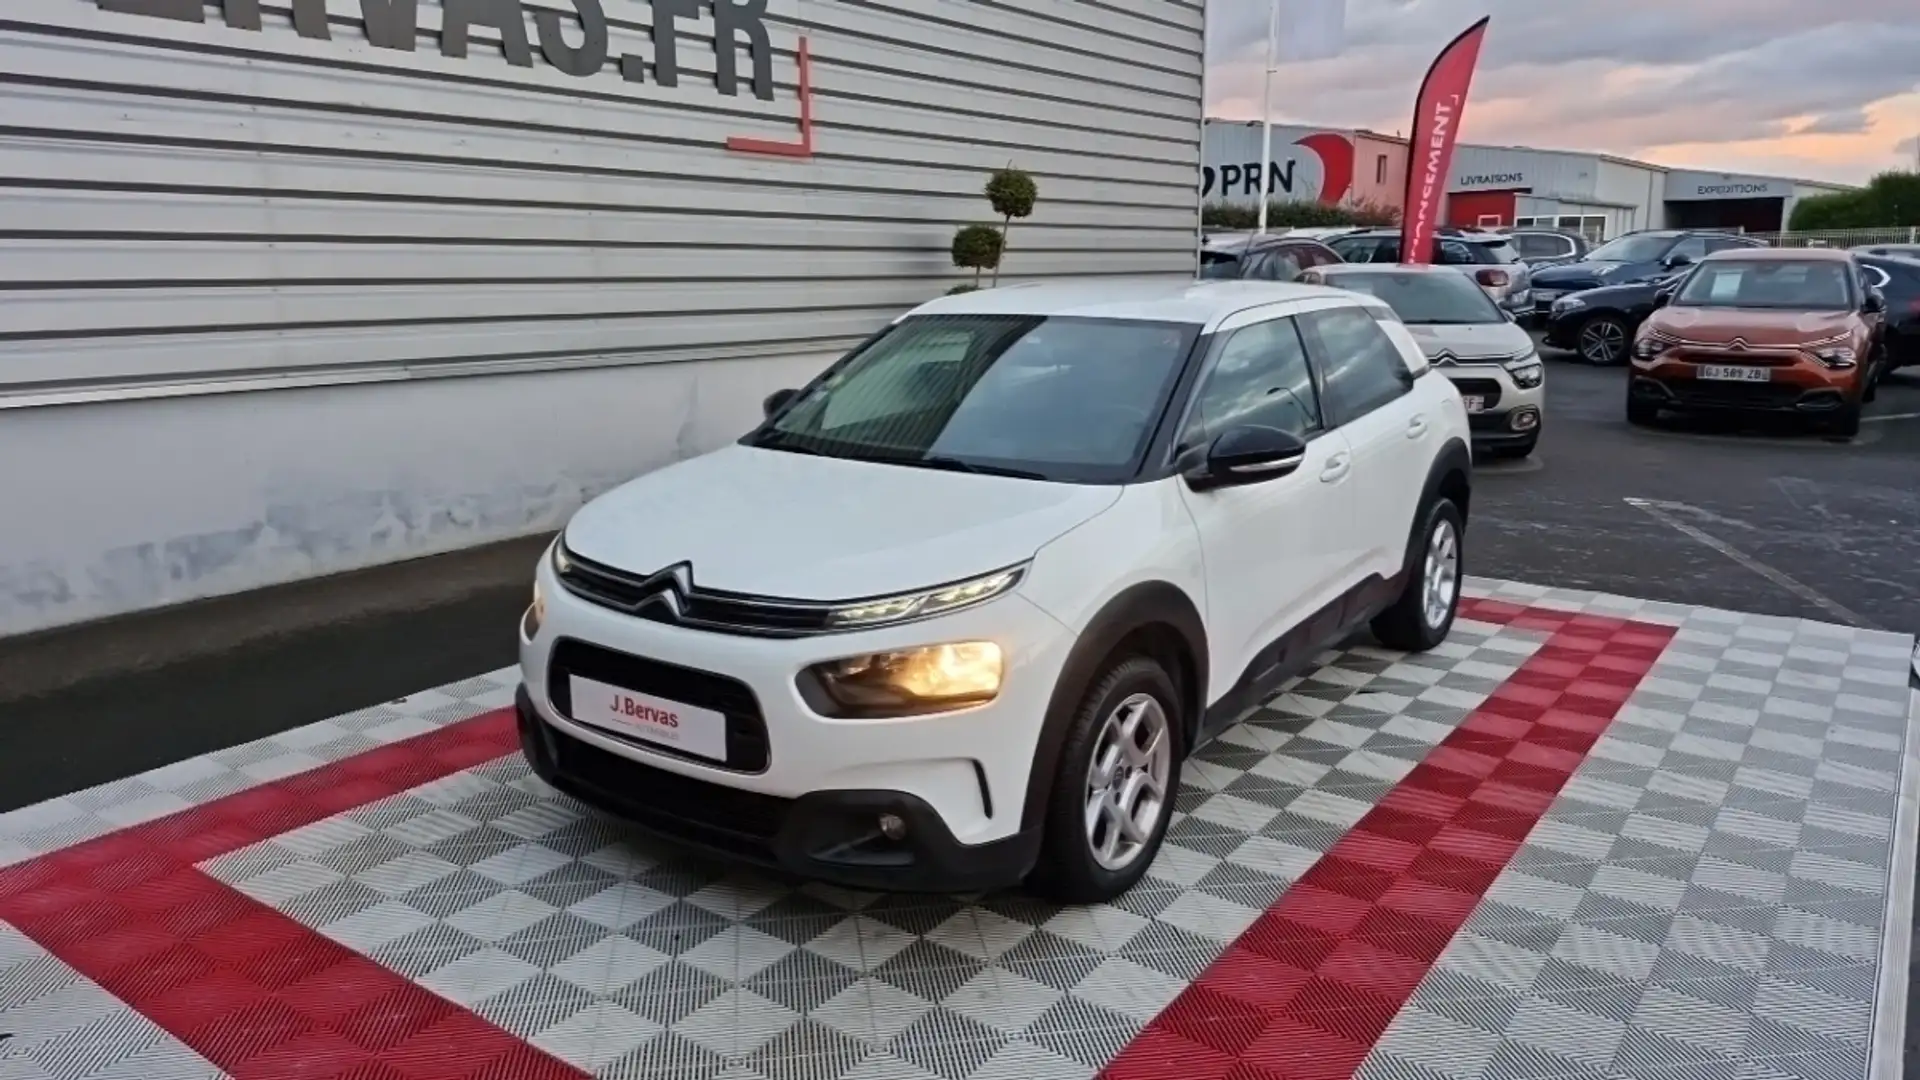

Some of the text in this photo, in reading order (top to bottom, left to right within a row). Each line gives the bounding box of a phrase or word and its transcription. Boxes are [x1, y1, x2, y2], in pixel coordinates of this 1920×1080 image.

[1219, 160, 1296, 196] PRN
[1460, 172, 1524, 186] LIVRAISONS
[609, 694, 679, 728] J.Bervas
